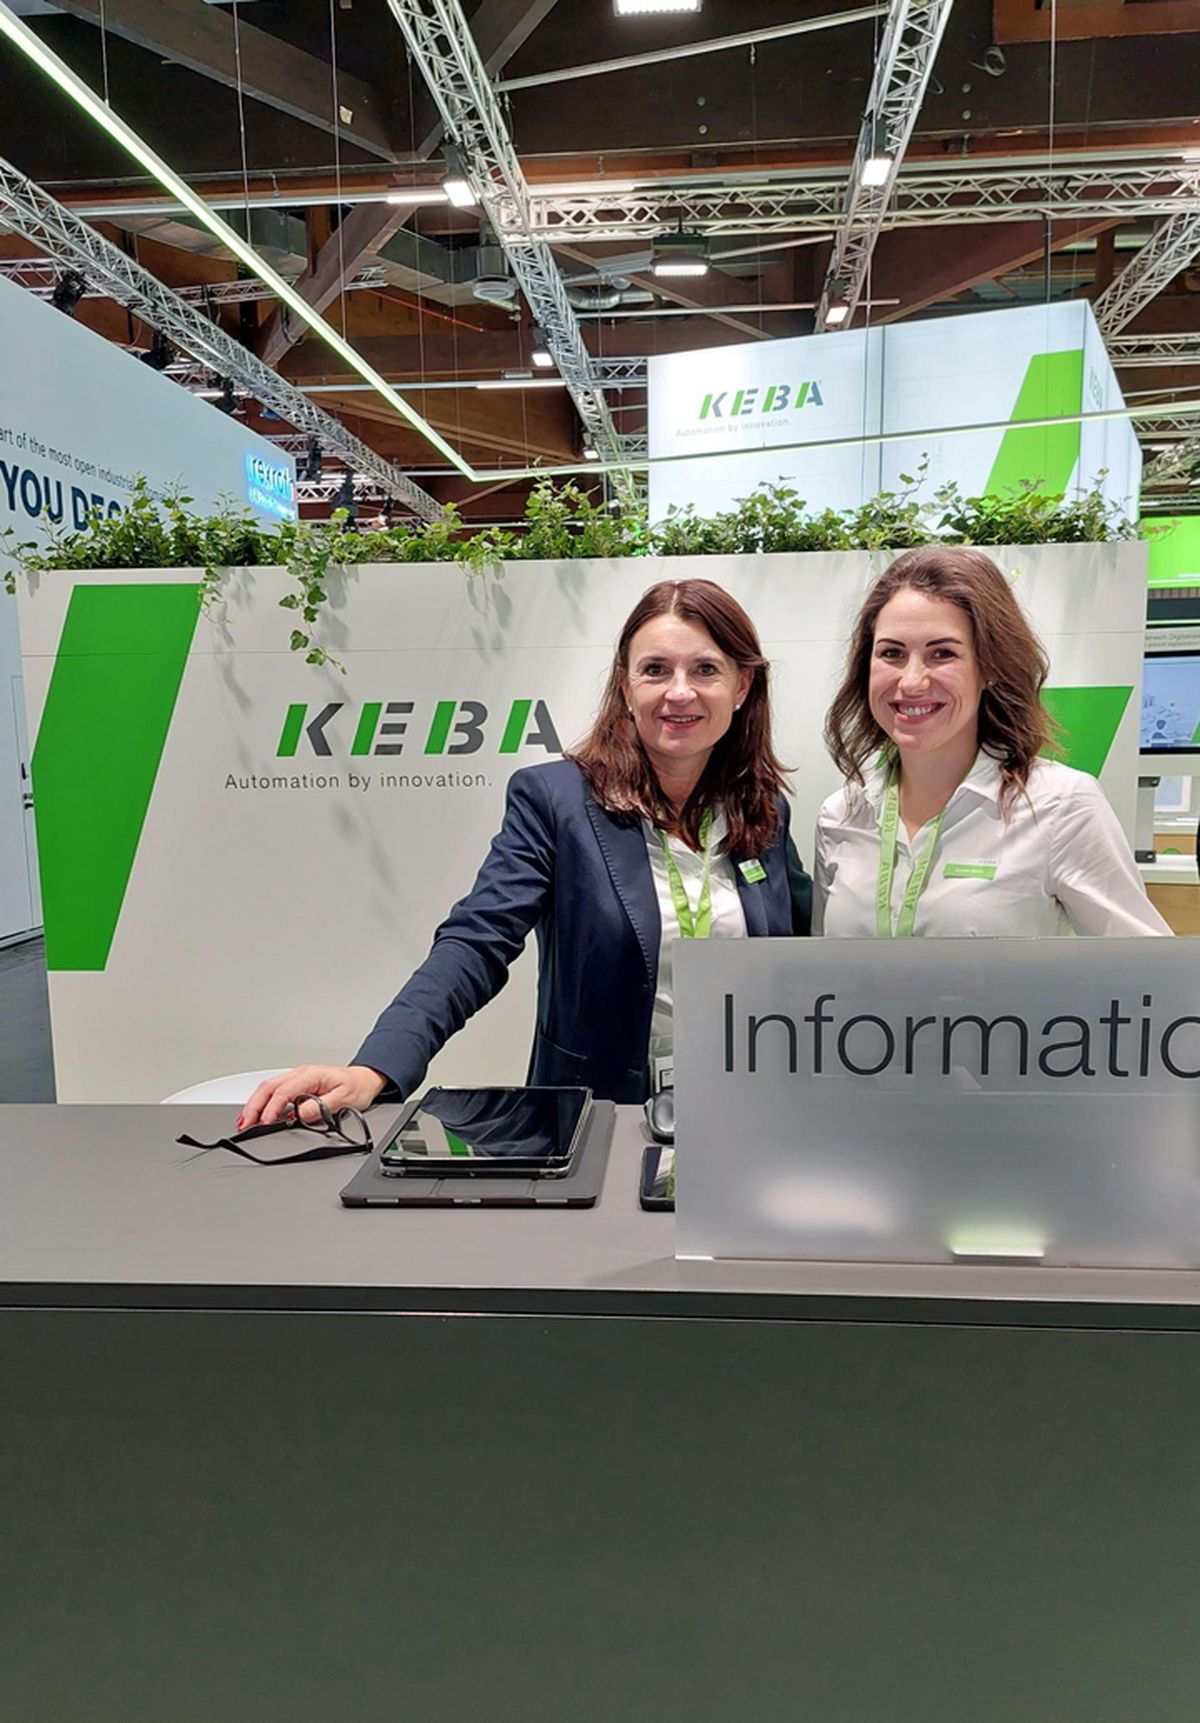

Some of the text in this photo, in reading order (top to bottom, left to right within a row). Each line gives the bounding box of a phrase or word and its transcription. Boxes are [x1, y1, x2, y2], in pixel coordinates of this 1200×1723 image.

[699, 381, 824, 419] KEBA
[728, 423, 739, 433] by
[16, 432, 26, 450] of
[29, 436, 46, 457] the
[49, 447, 73, 468] most
[74, 458, 97, 477] open
[0, 459, 63, 525] YOU
[276, 700, 564, 757] KEBA
[224, 771, 492, 792] Automation by innovation.
[724, 993, 1200, 1080] Informatio
